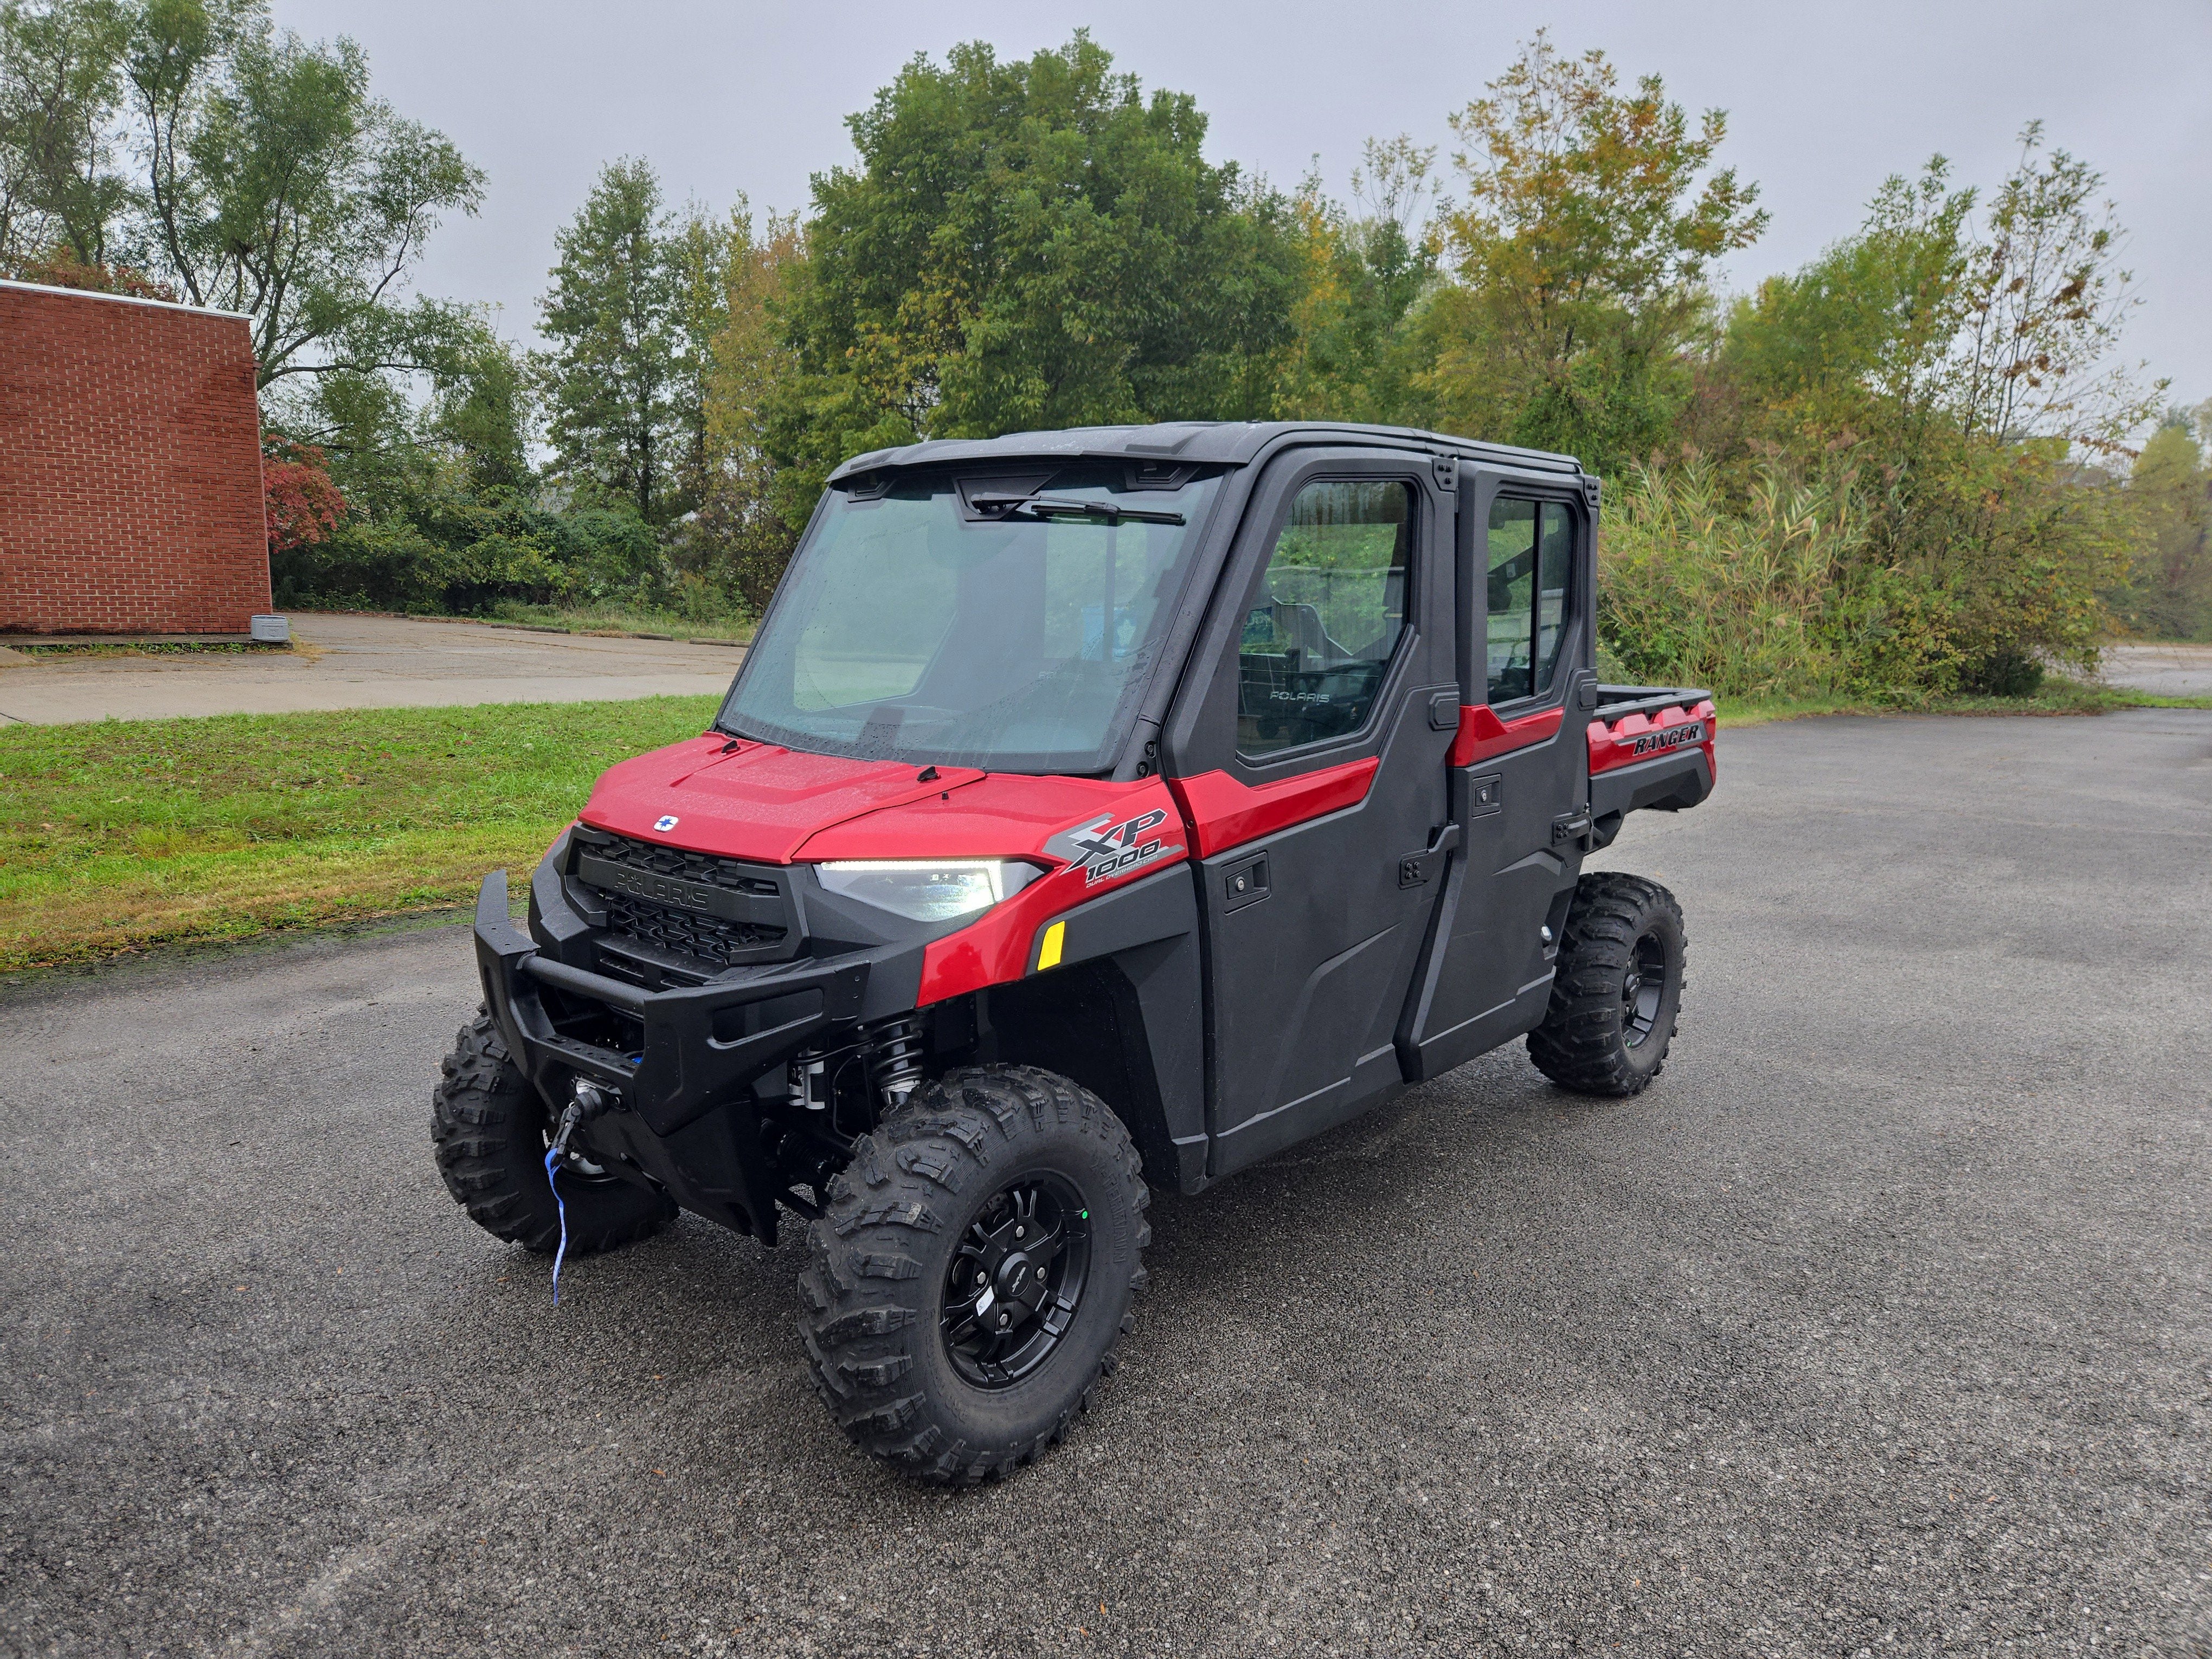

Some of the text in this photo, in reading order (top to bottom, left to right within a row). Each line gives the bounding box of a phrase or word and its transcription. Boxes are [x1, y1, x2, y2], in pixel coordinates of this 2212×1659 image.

[1269, 691, 1330, 703] POLARIS
[1632, 725, 1699, 756] RANGER
[1059, 808, 1168, 876] XP
[1085, 838, 1160, 884] 1000
[1086, 854, 1158, 889] DUAL OVERHEAD CAM
[614, 872, 708, 910] POLARIS
